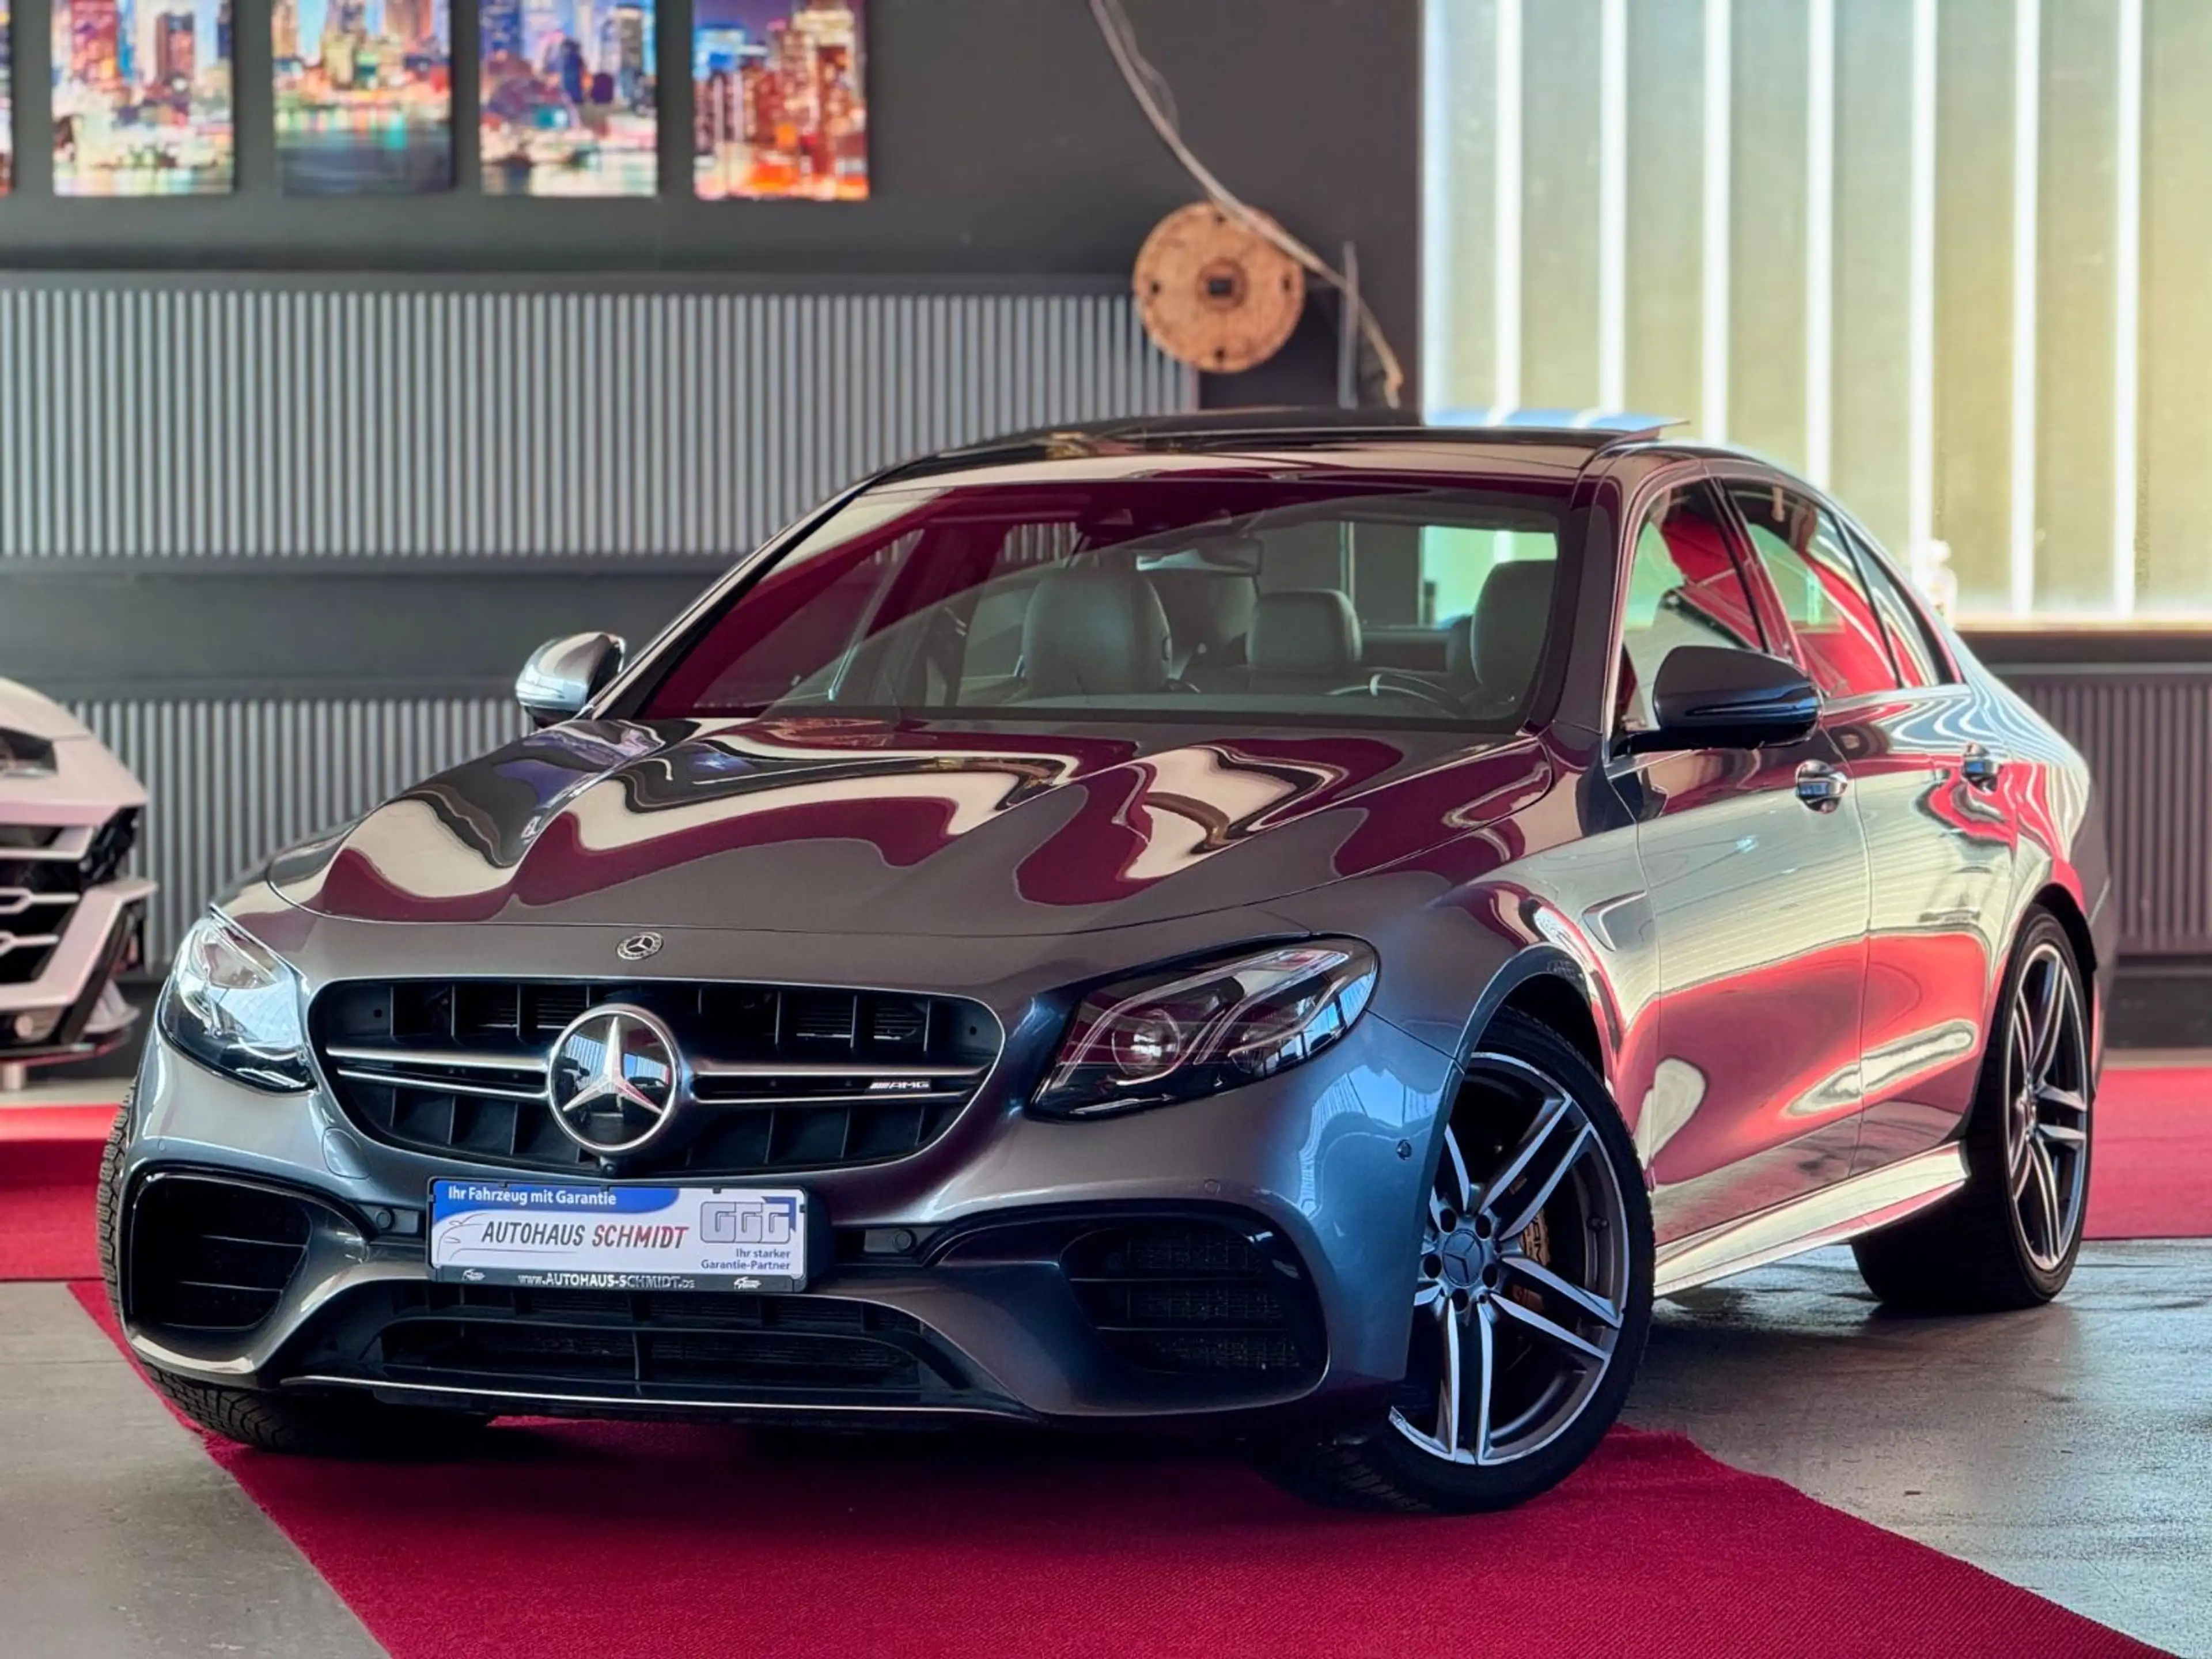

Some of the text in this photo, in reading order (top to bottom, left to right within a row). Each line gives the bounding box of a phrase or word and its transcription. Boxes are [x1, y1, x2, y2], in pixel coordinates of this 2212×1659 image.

[889, 1081, 930, 1089] AMG
[449, 1185, 616, 1206] Ihr Fahrzeug mit Garantie
[482, 1221, 690, 1249] AUTOHAUS SCHMIDT
[736, 1248, 791, 1259] Ihr starker
[700, 1259, 790, 1270] Garantie-Partner
